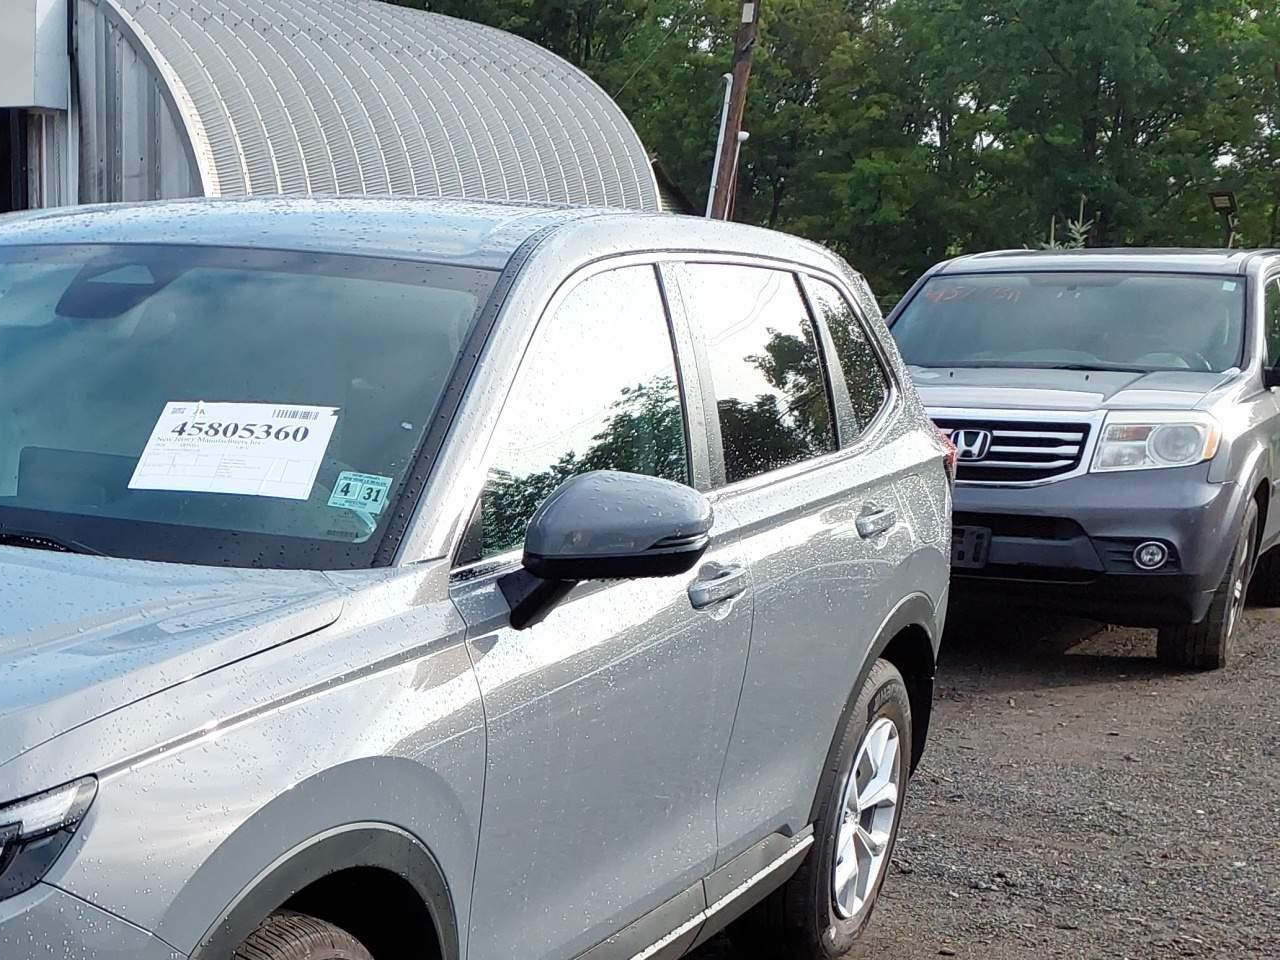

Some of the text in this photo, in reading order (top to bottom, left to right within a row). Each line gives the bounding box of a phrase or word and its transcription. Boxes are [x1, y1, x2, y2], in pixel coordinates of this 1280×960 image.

[170, 421, 310, 443] 45805360
[340, 482, 382, 503] 4 31
